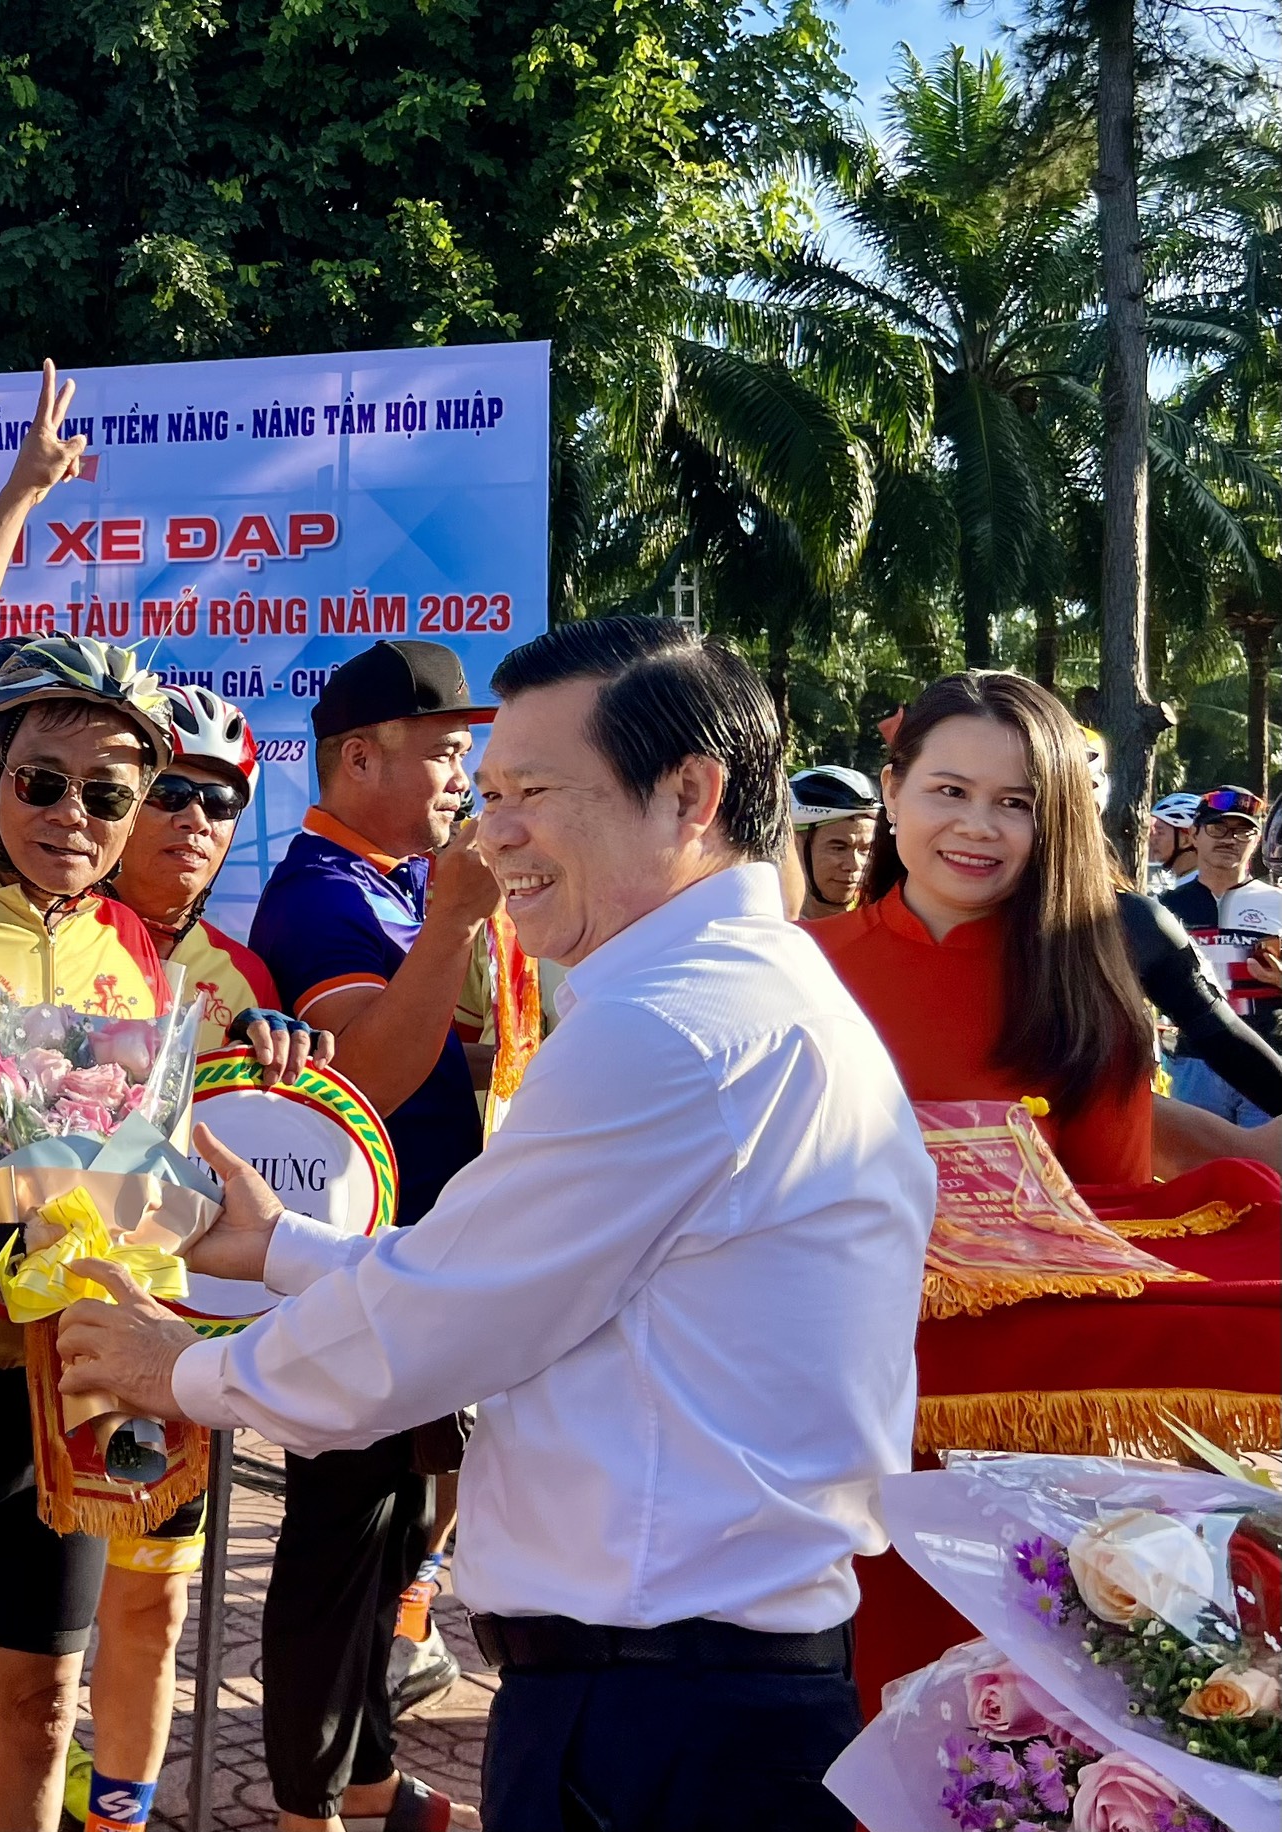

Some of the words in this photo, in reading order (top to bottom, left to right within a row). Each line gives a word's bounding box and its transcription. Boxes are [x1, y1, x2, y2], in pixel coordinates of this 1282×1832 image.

[102, 402, 159, 445] TIỀM
[167, 405, 229, 444] NĂNG
[252, 400, 316, 439] NÂNG
[323, 391, 376, 435] TẦM
[385, 393, 426, 440] HỘI
[436, 389, 503, 437] NHẬP
[46, 519, 142, 564] XE
[166, 513, 336, 568] ĐẠP
[67, 594, 130, 638] TÀU
[142, 588, 198, 638] MỞ
[208, 590, 308, 643] RỘNG
[320, 589, 406, 634] NĂM
[420, 594, 511, 632] 2023
[222, 666, 265, 697] GIÃ
[255, 739, 306, 762] 2023
